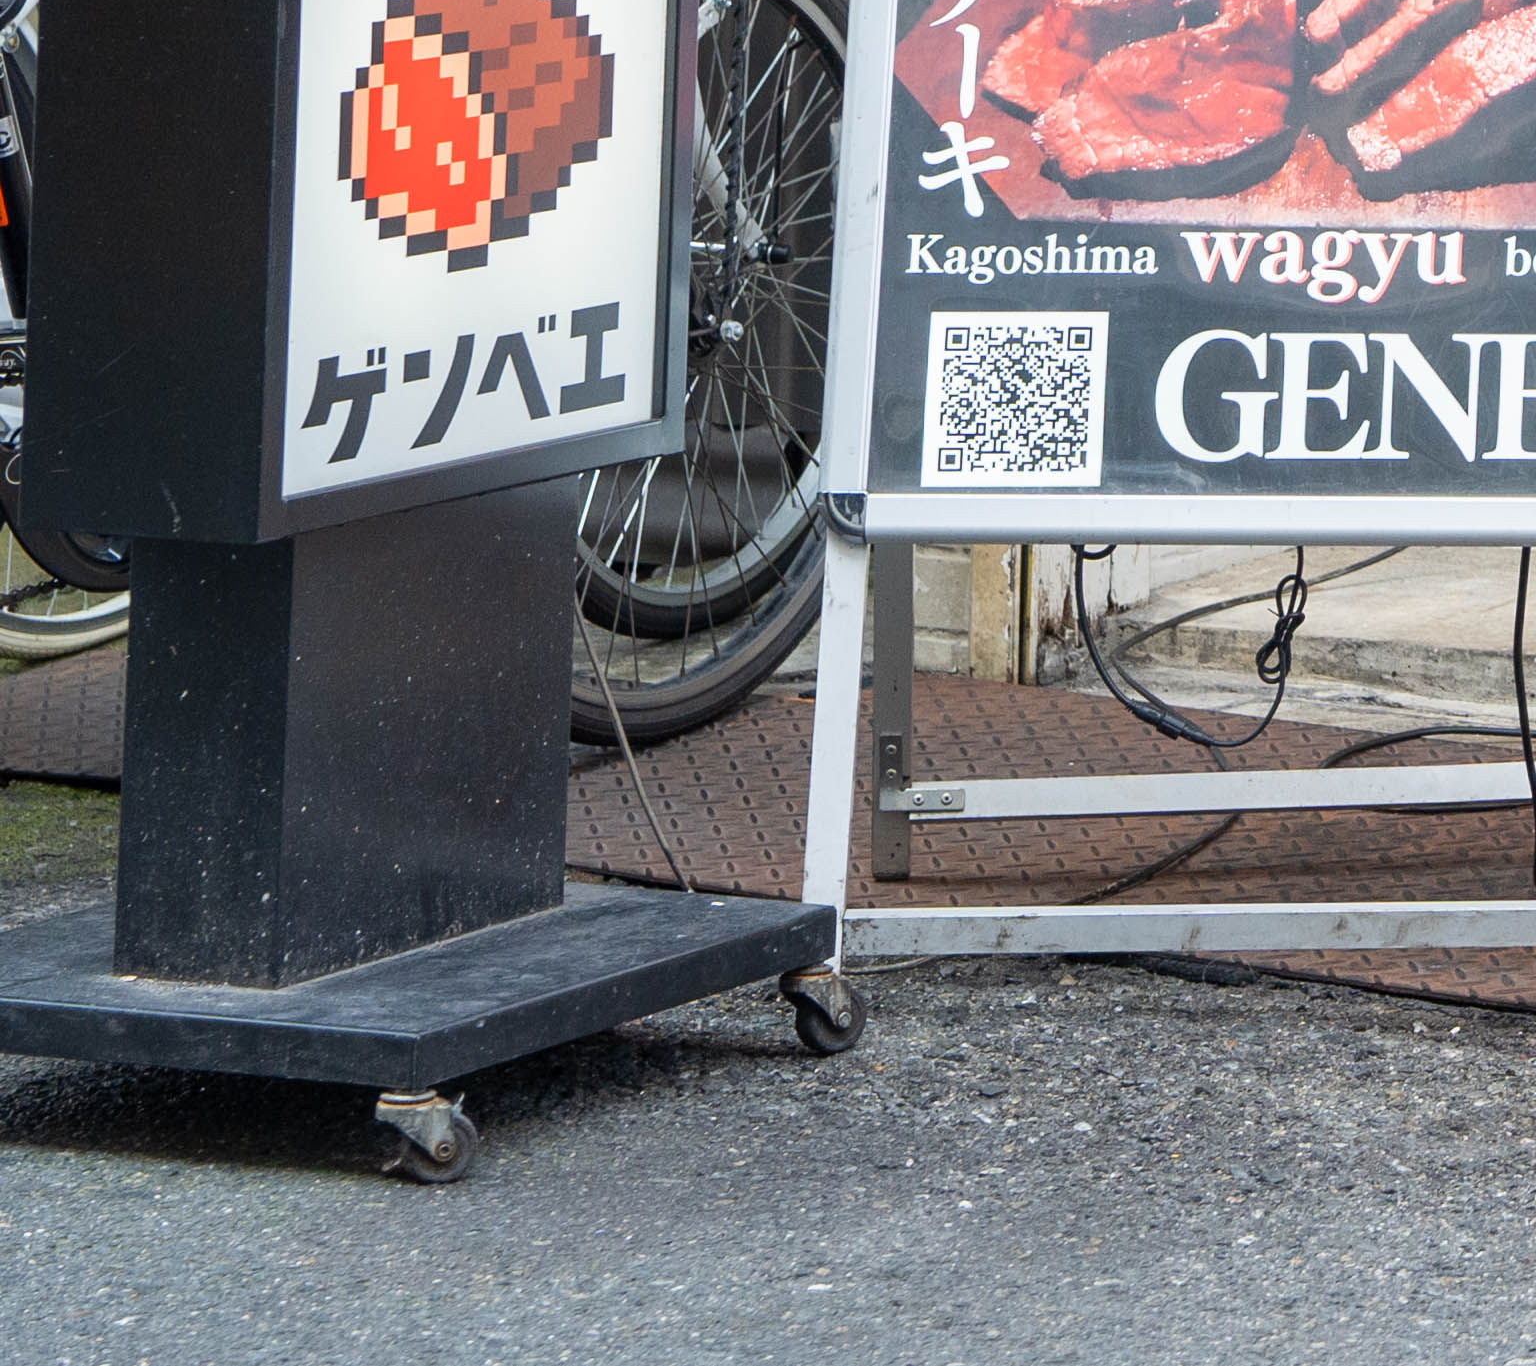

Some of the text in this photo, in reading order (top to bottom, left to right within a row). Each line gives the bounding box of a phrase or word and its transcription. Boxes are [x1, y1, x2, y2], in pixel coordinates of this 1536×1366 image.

[907, 234, 1158, 285] Kagoshima
[1180, 229, 1467, 303] wagyu
[301, 303, 627, 464] ゲンベエ
